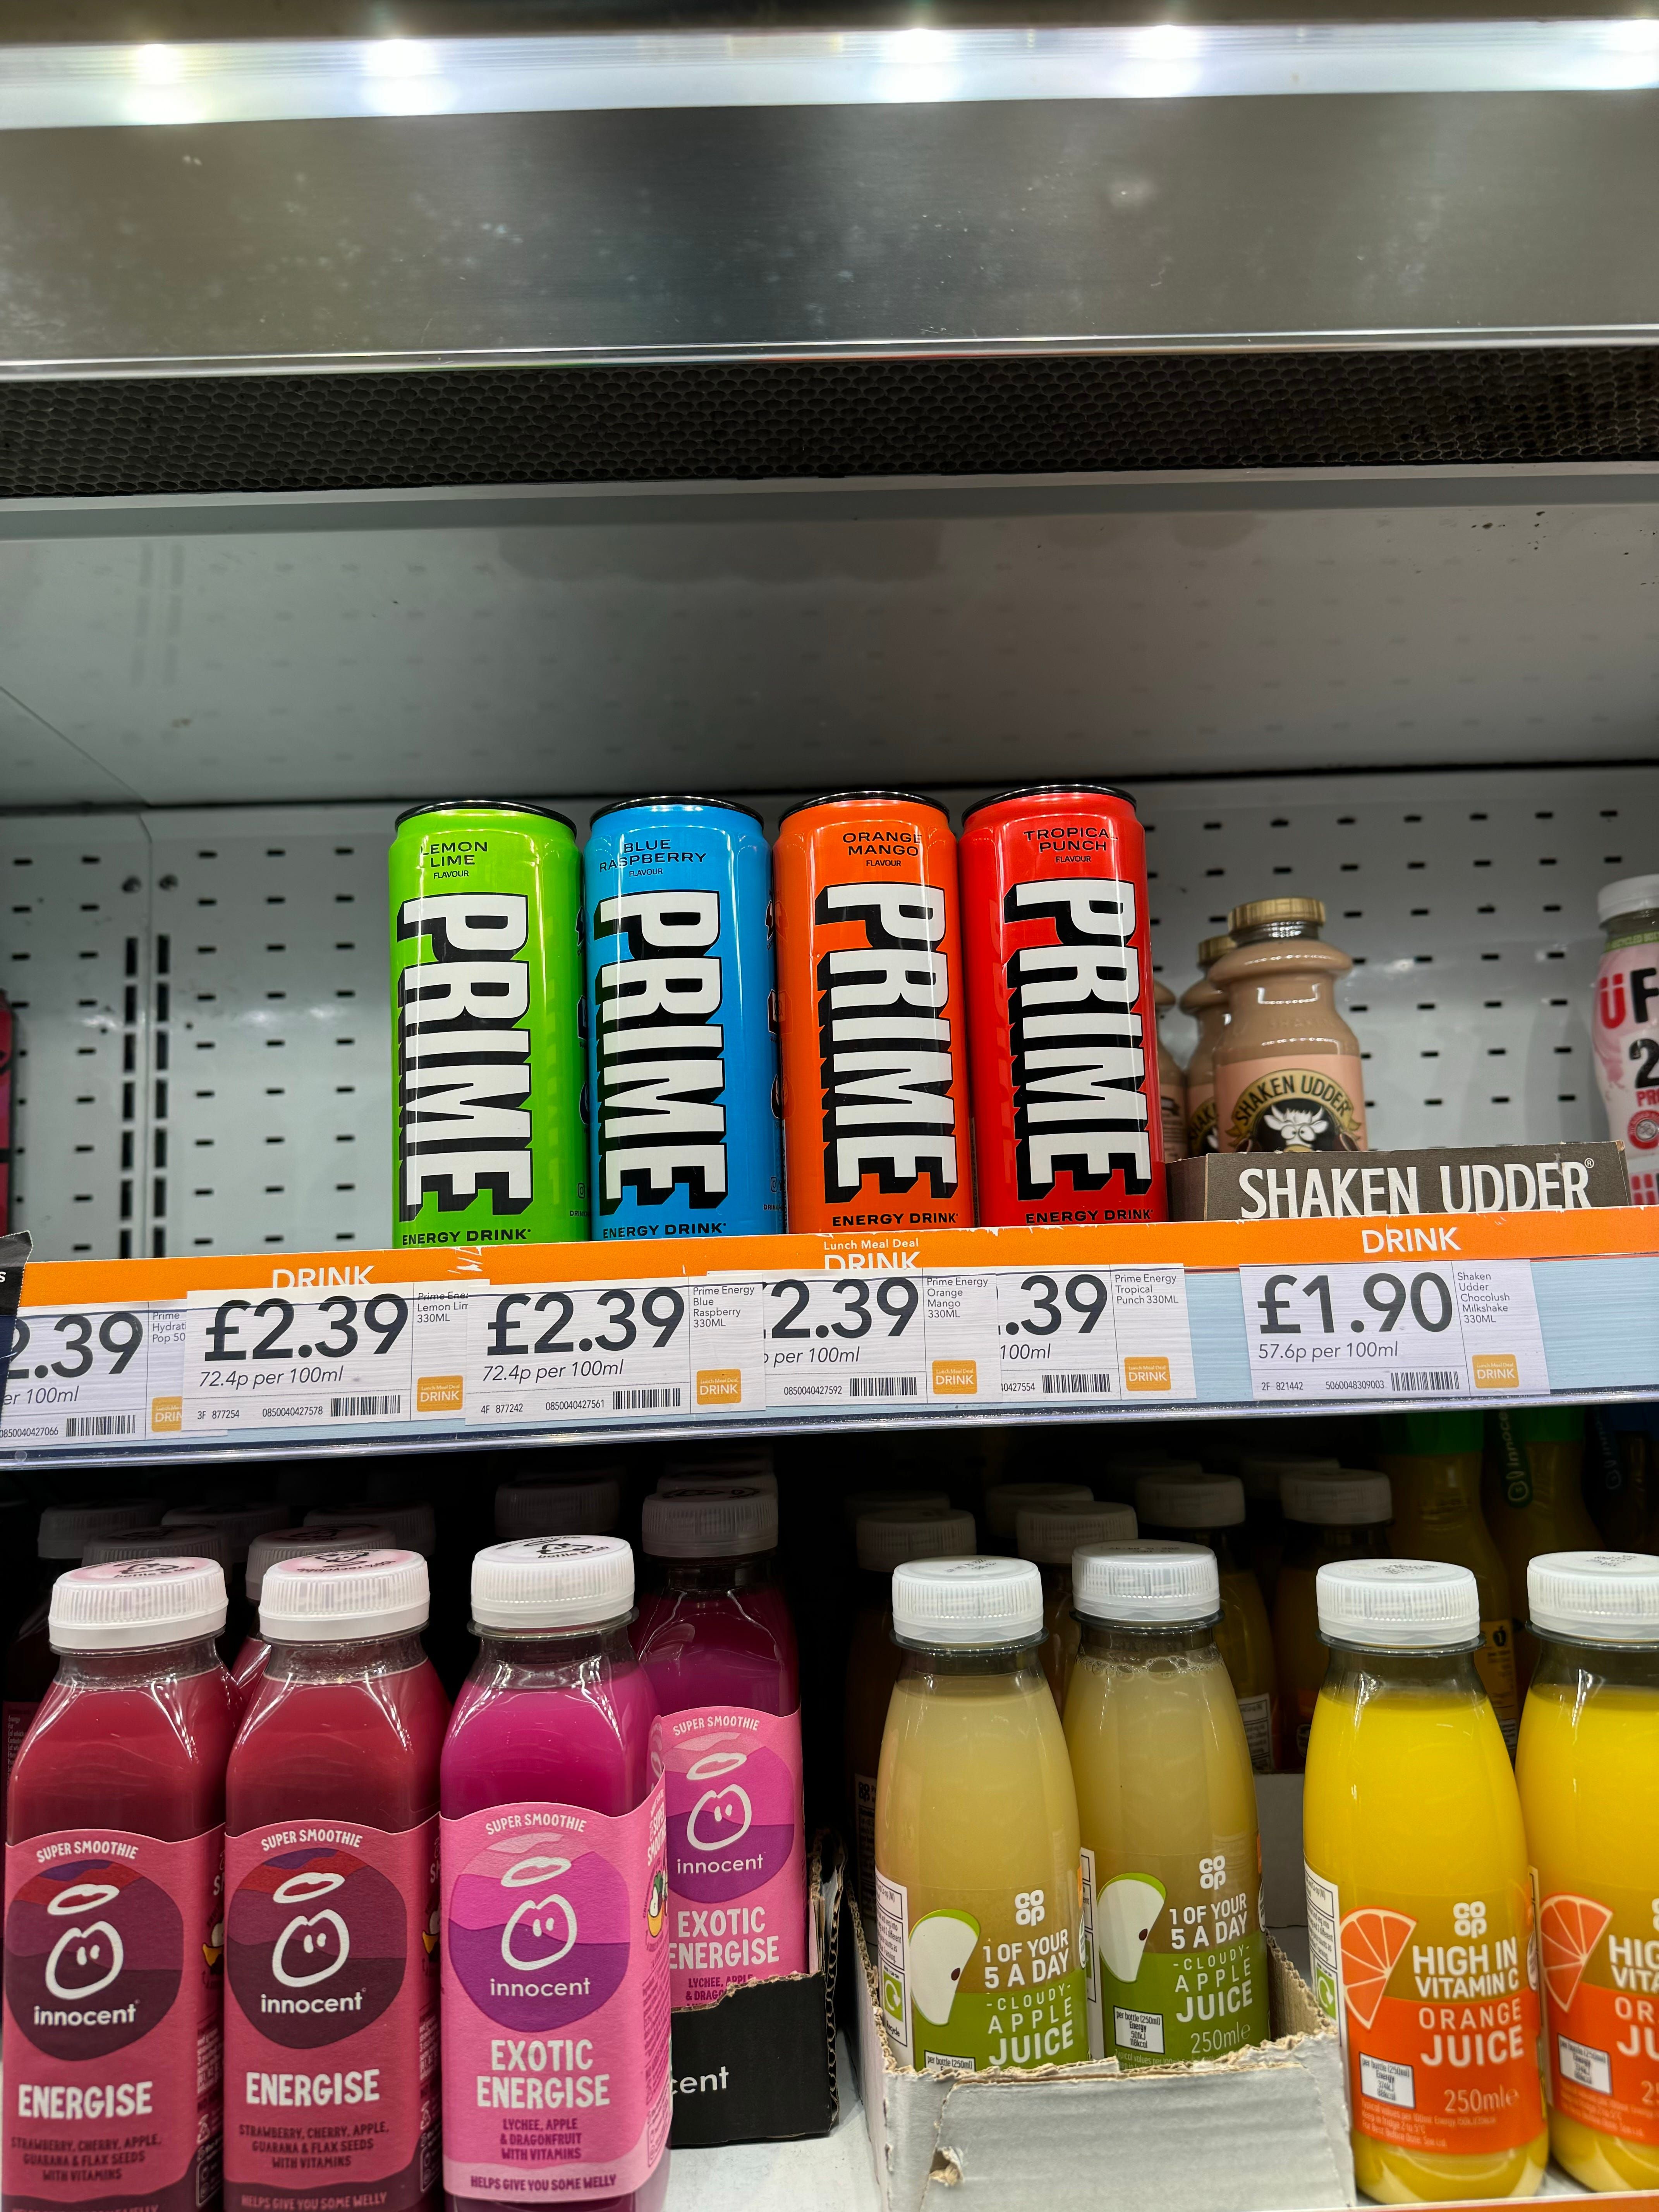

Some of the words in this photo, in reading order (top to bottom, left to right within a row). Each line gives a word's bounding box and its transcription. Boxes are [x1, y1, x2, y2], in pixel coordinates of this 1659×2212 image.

[843, 832, 921, 844] ORANGE
[1024, 827, 1118, 841] TROPICA
[420, 842, 487, 855] LEMON
[623, 839, 671, 853] BLUE
[848, 843, 919, 856] MANGO
[1039, 840, 1106, 853] PUNCH
[430, 855, 475, 867] LIME
[599, 852, 706, 872] RASPBERRY
[1056, 855, 1091, 864] FLAVOUR
[433, 870, 469, 879] FLAVOUR
[629, 867, 663, 877] FLAVOUR
[815, 882, 958, 1203] PRIME
[1004, 879, 1153, 1200] PRIME
[397, 892, 533, 1222] PRIME
[594, 890, 727, 1216] PRIME
[1235, 1075, 1295, 1126] SHAKEN
[1301, 1075, 1351, 1117] UDDER
[1239, 1166, 1419, 1219] SHAKEN
[833, 1213, 903, 1226] ENERGY
[910, 1212, 956, 1223] DRINK
[1026, 1211, 1098, 1224] ENERGY
[1104, 1209, 1151, 1221] DRINK
[402, 1231, 461, 1245] ENERGY
[467, 1229, 528, 1242] DRINK
[603, 1225, 659, 1239] ENERGY
[665, 1223, 724, 1235] DRINK
[824, 1240, 857, 1250] Lunch
[861, 1239, 889, 1249] Meal
[893, 1238, 919, 1248] Deal
[1362, 1226, 1462, 1254] DRINK
[824, 1252, 921, 1269] DRINK
[273, 1265, 375, 1288] DRINK
[927, 1278, 953, 1286] Prime
[956, 1277, 988, 1287] Energy
[1115, 1274, 1141, 1283] Prime
[1144, 1274, 1176, 1284] Energy
[1458, 1272, 1491, 1280] Shaken
[693, 1286, 719, 1295] Prime
[722, 1285, 754, 1296] Energy
[927, 1288, 963, 1298] Orange
[1115, 1285, 1152, 1295] Tropical
[1459, 1283, 1489, 1291] Udder
[693, 1297, 714, 1306] Blue
[927, 1300, 960, 1309] Mango
[1117, 1295, 1144, 1304] Punch
[1147, 1295, 1178, 1304] 330ML
[1257, 1272, 1452, 1334] £1.90
[1461, 1293, 1510, 1301] Chocolush
[417, 1303, 450, 1312] Lemon
[693, 1307, 740, 1318] Raspberry
[763, 1278, 919, 1338] 2.39
[996, 1274, 1107, 1336] .39
[1463, 1304, 1508, 1312] Milkshake
[153, 1312, 180, 1321] Prime
[417, 1314, 450, 1323] 330ML
[928, 1310, 960, 1318] 330ML
[1464, 1315, 1496, 1323] 330ML
[204, 1293, 408, 1361] £2.39
[487, 1288, 685, 1356] £2.39
[694, 1318, 726, 1328] 330ML
[152, 1334, 170, 1343] Pop
[774, 1351, 803, 1368] per
[809, 1347, 860, 1362] 100ml
[1000, 1344, 1050, 1360] 100ml
[1259, 1345, 1307, 1363] 57.6p
[1312, 1346, 1340, 1362] per
[1348, 1341, 1398, 1357] 100ml
[199, 1370, 248, 1390] 72.4p
[253, 1372, 284, 1390] per
[290, 1365, 343, 1384] 100ml
[483, 1364, 531, 1383] 72.4p
[535, 1364, 566, 1382] per
[572, 1359, 623, 1377] 100ml
[1128, 1371, 1167, 1382] DRINK
[1477, 1369, 1515, 1379] DRINK
[936, 1375, 974, 1385] DRINK
[1262, 1382, 1270, 1390] 2F
[1276, 1381, 1303, 1390] 821442
[1326, 1380, 1384, 1390] 5060048309003
[26, 1386, 79, 1404] 100ml
[420, 1391, 459, 1402] DRINK
[700, 1384, 738, 1395] DRINK
[784, 1385, 842, 1395] 0850040427592
[263, 1406, 323, 1418] 0850040427578
[481, 1405, 489, 1414] 4F
[496, 1403, 523, 1413] 877242
[546, 1399, 605, 1411] 0850040427561
[198, 1410, 206, 1420] 3F
[212, 1410, 240, 1419] 877254
[673, 1718, 704, 1736] SUPER
[707, 1716, 760, 1731] SMOOTHIE
[486, 1815, 522, 1835] SUPER
[524, 1814, 587, 1832] SMOOTHIE
[261, 1831, 297, 1851] SUPER
[299, 1829, 363, 1848] SMOOTHIE
[36, 1842, 71, 1863] SUPER
[75, 1841, 139, 1859] SMOOTHIE
[677, 1854, 763, 1874] innocent
[1170, 1908, 1177, 1925] 1
[1183, 1905, 1206, 1924] OF
[1211, 1893, 1246, 1920] YOUR
[678, 1906, 765, 1937] EXOTIC
[1171, 1929, 1185, 1950] 5
[1193, 1925, 1209, 1948] A
[1216, 1911, 1248, 1944] DAY
[670, 1936, 779, 1970] ENERGISE
[983, 1946, 991, 1963] 1
[997, 1942, 1022, 1962] OF
[1027, 1929, 1068, 1958] YOUR
[1413, 1944, 1489, 1975] HIGH
[1495, 1937, 1518, 1970] IN
[985, 1967, 999, 1989] 5
[1007, 1963, 1025, 1987] A
[1032, 1948, 1070, 1983] DAY
[1175, 1958, 1251, 1993] APPLE
[490, 1978, 591, 1997] innocent
[1415, 1973, 1505, 1999] VITAMIN
[1508, 1967, 1519, 1990] C
[260, 1992, 362, 2013] innocent
[1176, 1979, 1253, 2023] JUICE
[34, 2004, 136, 2026] innocent
[988, 1996, 1072, 2034] APPLE
[1125, 2012, 1139, 2022] bottle
[1140, 2013, 1160, 2025] (250ml)
[1419, 1998, 1521, 2031] ORANGE
[1130, 2021, 1147, 2033] Energy
[989, 2020, 1074, 2066] JUICE
[1421, 2025, 1524, 2068] JUICE
[491, 2039, 593, 2071] EXOTIC
[246, 2069, 380, 2107] ENERGISE
[477, 2074, 610, 2109] ENERGISE
[19, 2081, 152, 2119] ENERGISE
[546, 2118, 578, 2130] APPLE
[500, 2134, 507, 2145] &
[510, 2133, 581, 2146] DRAGONFRUIT
[501, 2148, 527, 2160] WITH
[530, 2148, 581, 2160] VITAMINS
[471, 2176, 501, 2190] HELPS
[503, 2177, 526, 2190] GIVE
[528, 2178, 549, 2191] YOU
[551, 2177, 581, 2191] SOME
[584, 2174, 616, 2188] WELLY
